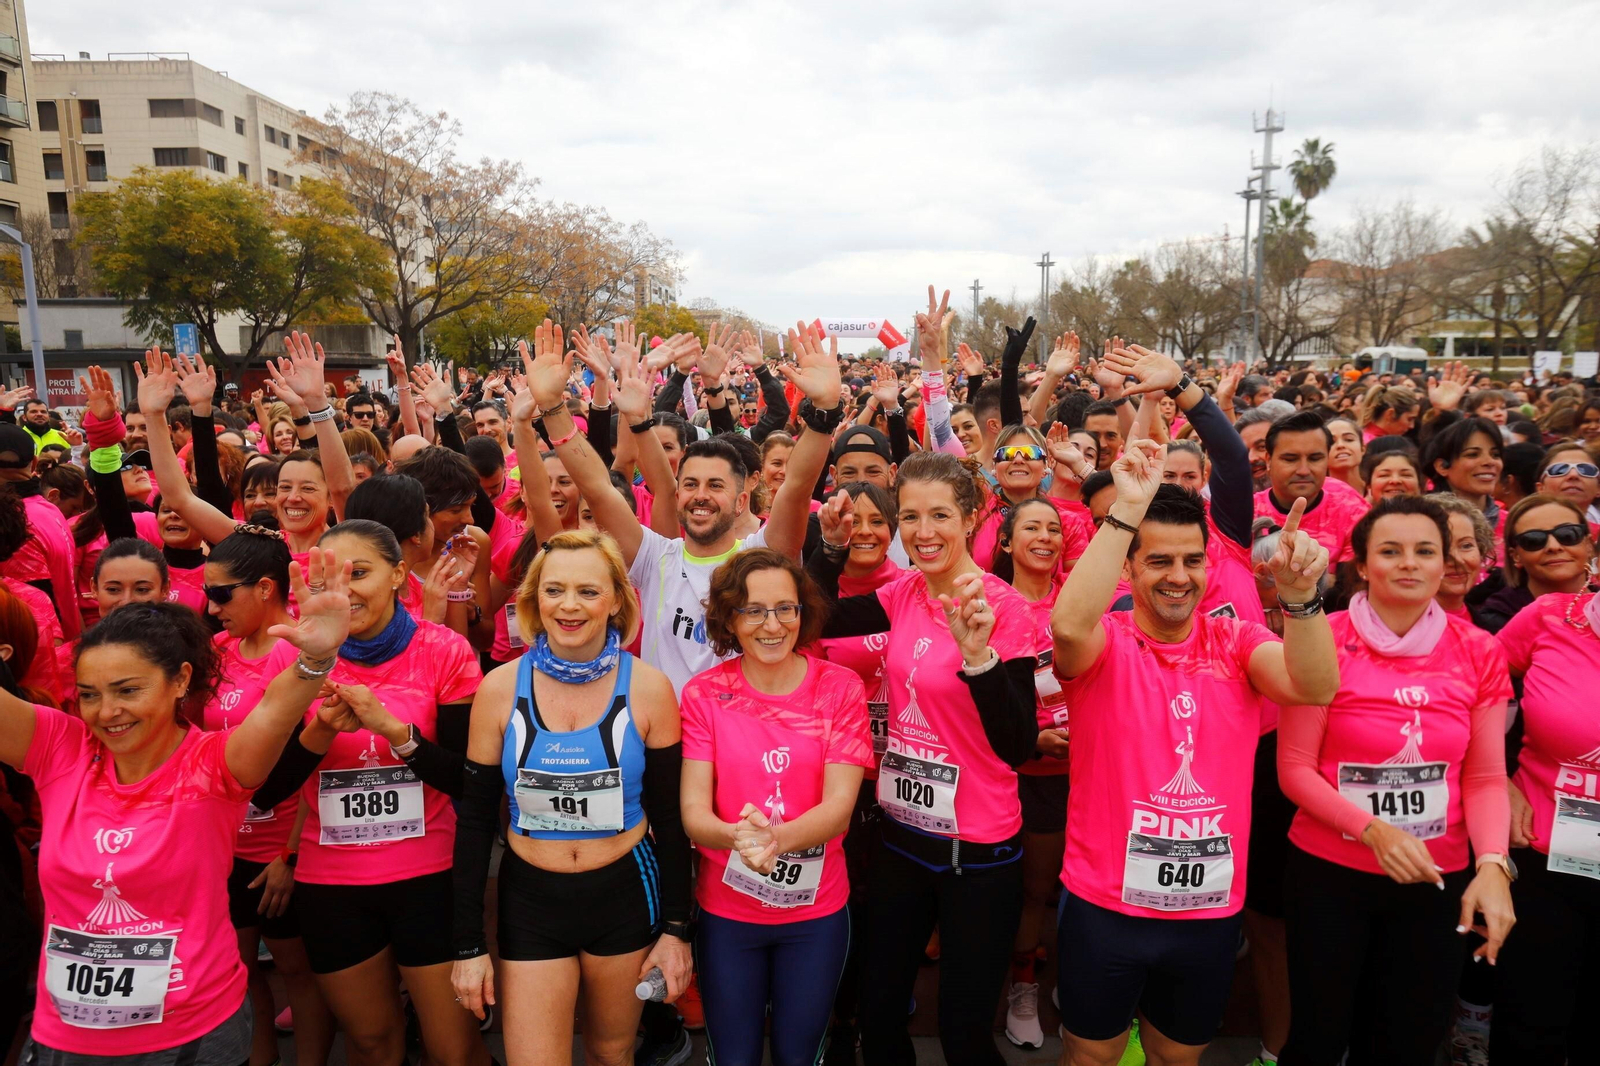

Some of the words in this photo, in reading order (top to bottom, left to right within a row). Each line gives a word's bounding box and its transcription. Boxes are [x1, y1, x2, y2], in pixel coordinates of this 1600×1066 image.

[828, 322, 867, 332] cajasur
[49, 379, 75, 387] PROTE
[903, 726, 939, 742] EDICIÓN
[894, 777, 934, 808] 1020
[1555, 766, 1600, 797] PI
[340, 790, 399, 818] 1389
[549, 796, 588, 818] 191
[1150, 794, 1168, 805] VIII
[1171, 796, 1216, 808] EDICIÓN
[1367, 790, 1425, 816] 1419
[239, 825, 252, 833] 23
[1132, 809, 1224, 839] PINK
[759, 860, 803, 885] 39
[1158, 862, 1205, 887] 640
[107, 920, 164, 935] DICIÓN
[66, 963, 135, 997] 1054
